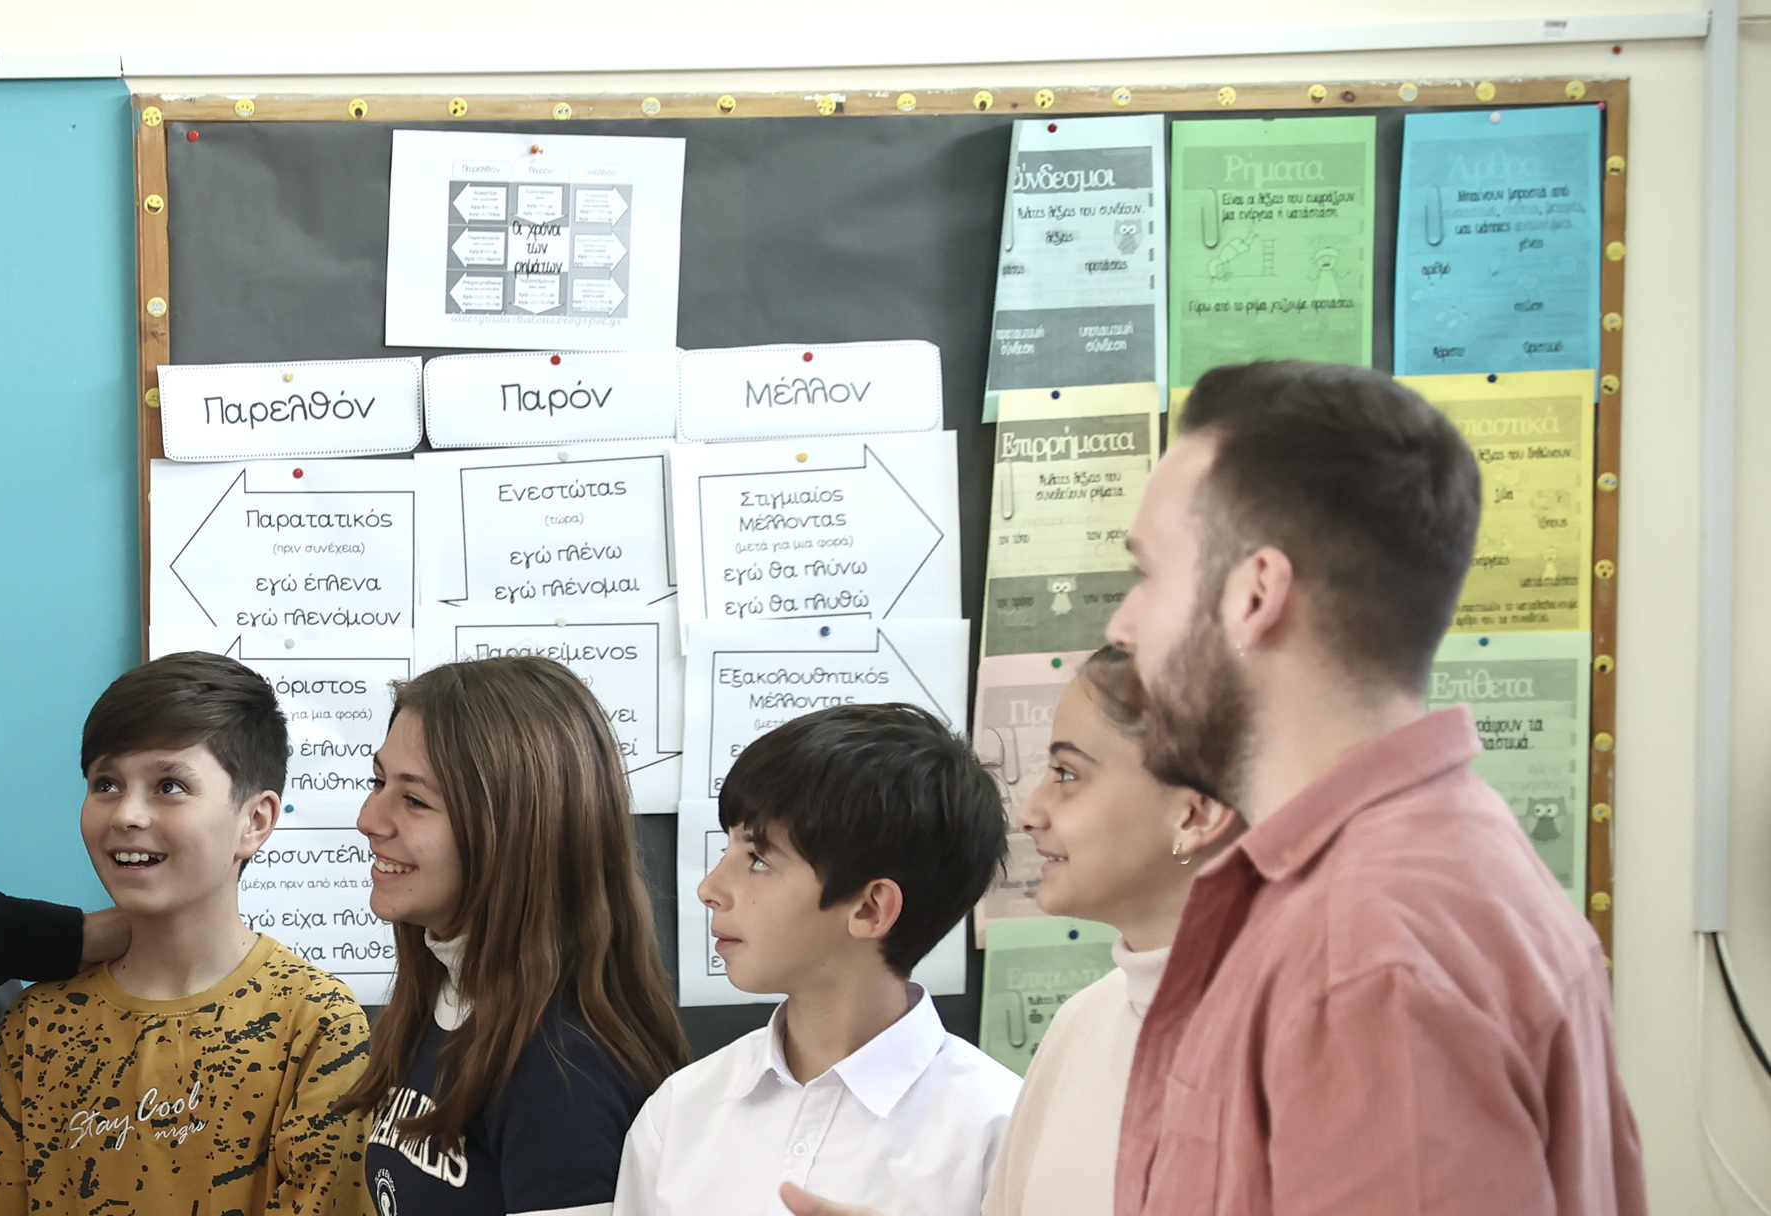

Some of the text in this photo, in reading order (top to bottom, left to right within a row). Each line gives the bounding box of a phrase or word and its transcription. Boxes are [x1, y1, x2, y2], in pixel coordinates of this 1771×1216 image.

[1224, 152, 1325, 190] Ρήματα
[526, 242, 549, 255] των
[514, 257, 563, 280] ρημάτων
[500, 380, 612, 416] Παρόν
[745, 377, 871, 408] Μέλλον
[204, 389, 376, 430] Παρελθόν
[1462, 404, 1561, 440] ιαστικά
[1001, 425, 1136, 463] Επιρρήματα
[498, 479, 627, 502] Ενεστώτας
[740, 485, 844, 510] Στιγμιαίος
[246, 508, 393, 531] Παρατατικός
[545, 512, 585, 527] (τώρα)
[739, 512, 847, 533] Μέλλοντας
[272, 541, 366, 556] (πριν συνέχεια)
[509, 541, 623, 569] εγώ πλένω
[772, 541, 791, 553] για
[794, 539, 813, 551] μια
[723, 557, 868, 586] εγώ θα πλύνω
[255, 572, 382, 596] εγώ έπλενα
[494, 577, 641, 604] εγώ πλένομαι
[724, 589, 869, 619] εγώ θα πλυθώ
[236, 606, 401, 628] εγώ πλενόμουν
[268, 675, 367, 698] όριστος
[718, 667, 890, 688] Εξακολουθητικός
[1428, 668, 1535, 701] Επίθετα
[311, 708, 333, 721] μια
[335, 707, 373, 722] φορά)
[300, 739, 375, 757] έπλυνα
[241, 878, 359, 892] (μέχρι πριν από κάτι
[281, 908, 327, 929] είχα
[69, 1080, 201, 1151] Stay Cool
